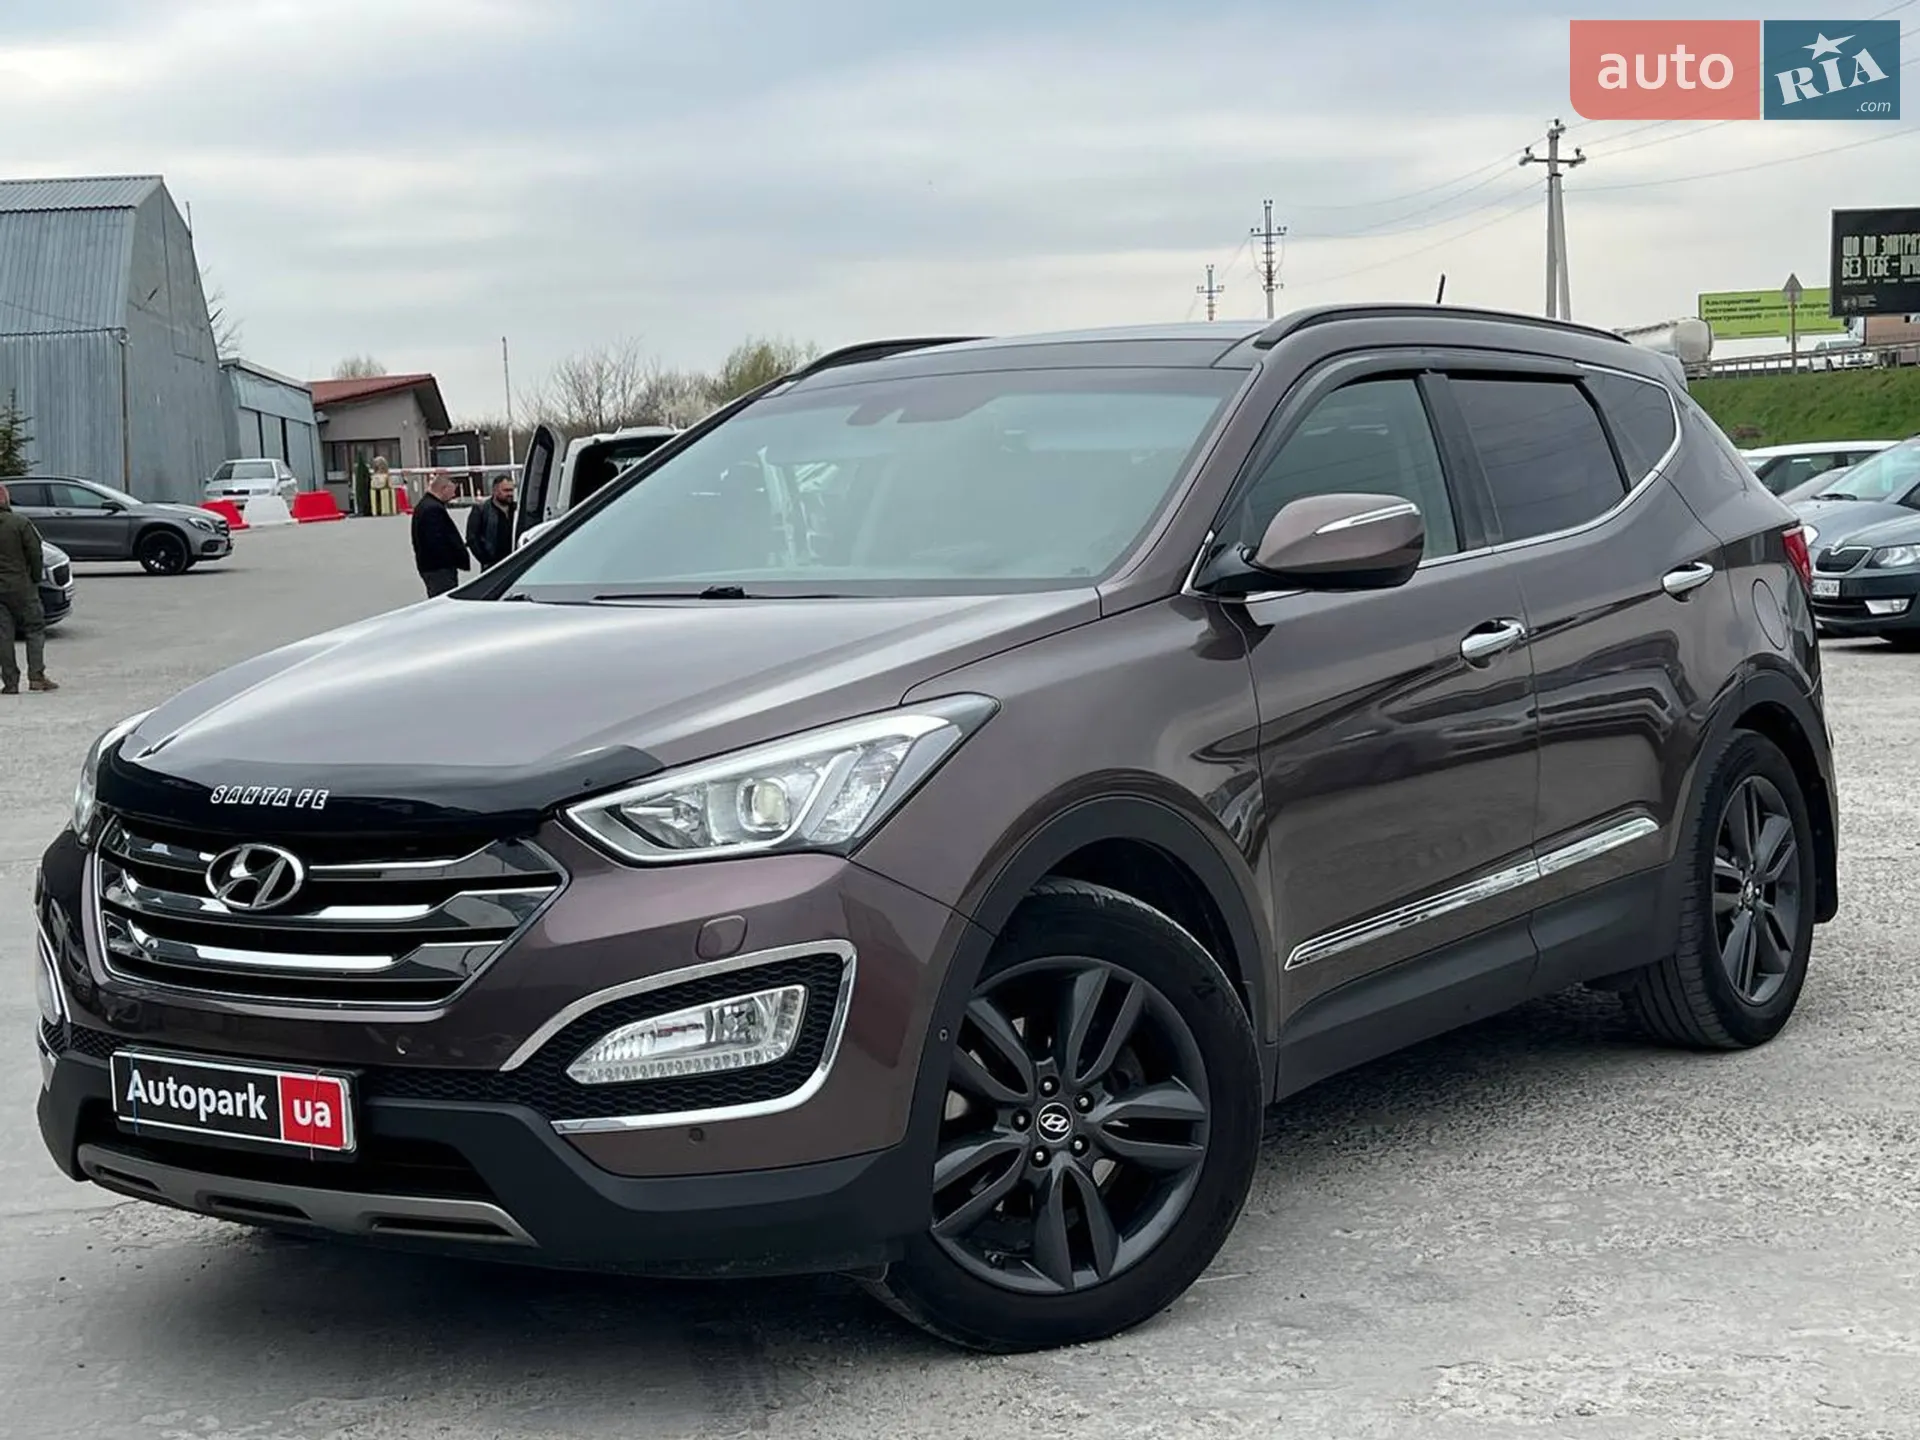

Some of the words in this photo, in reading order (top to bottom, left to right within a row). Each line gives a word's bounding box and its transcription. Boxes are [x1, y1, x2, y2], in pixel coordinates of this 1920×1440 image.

[210, 785, 293, 807] SANTA
[294, 788, 330, 810] FE
[126, 1069, 268, 1122] Autopark
[293, 1098, 332, 1128] ua
